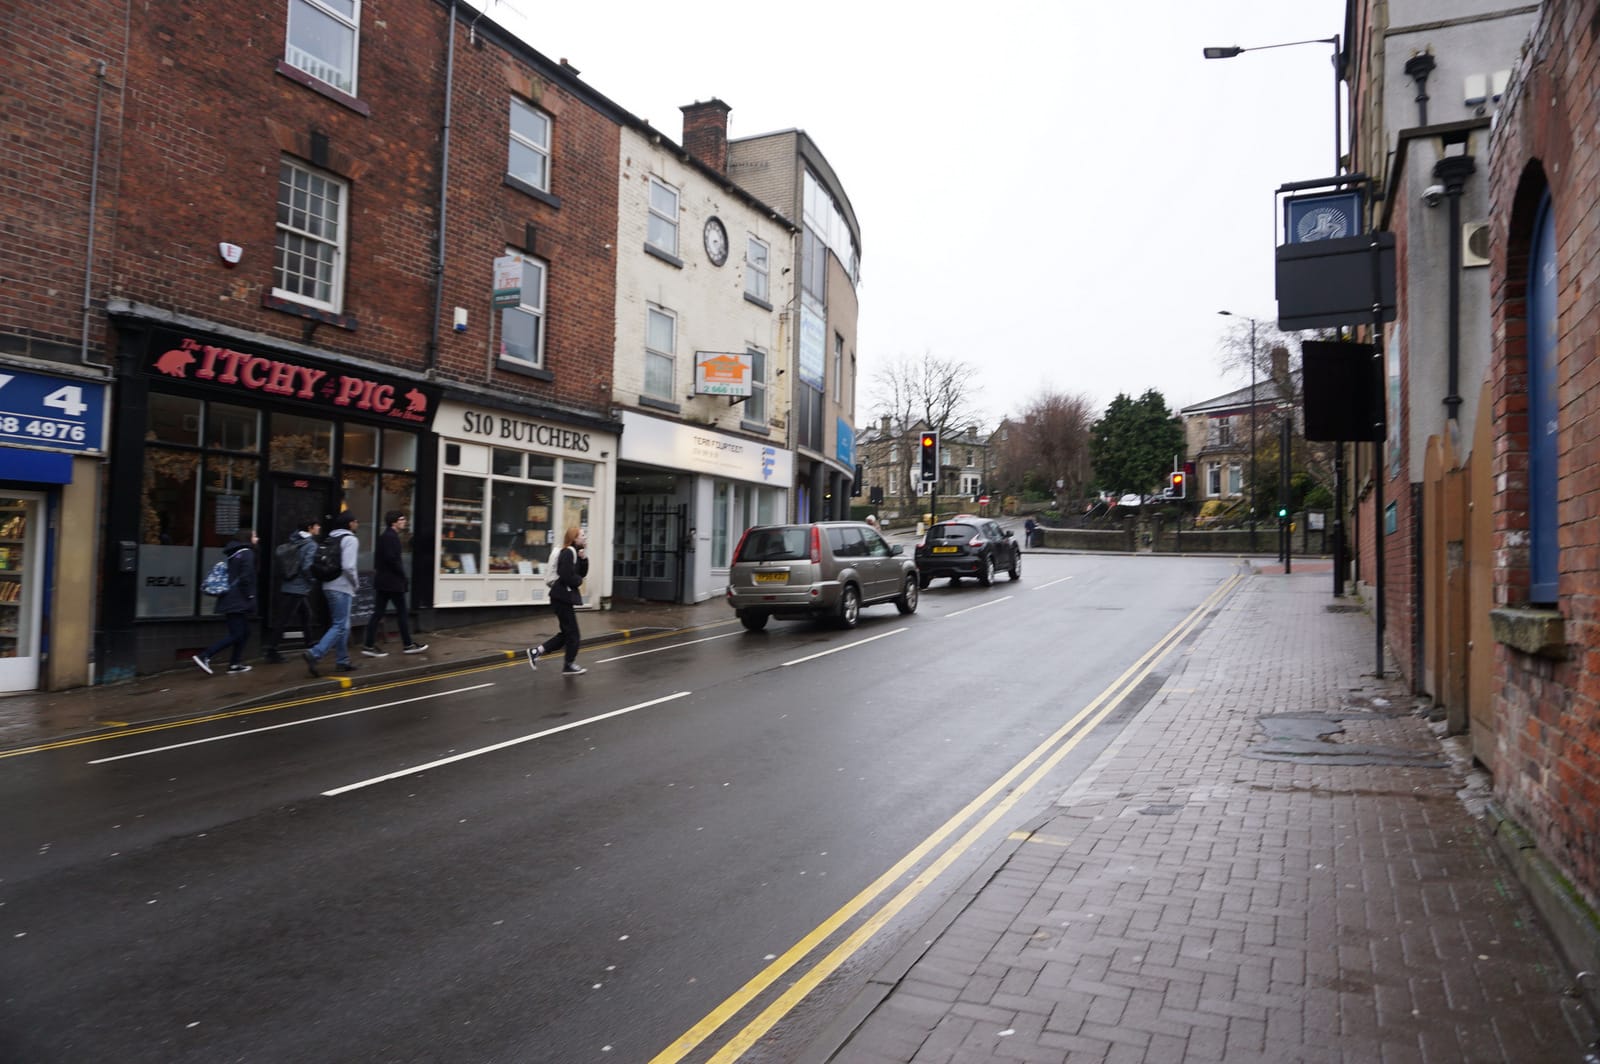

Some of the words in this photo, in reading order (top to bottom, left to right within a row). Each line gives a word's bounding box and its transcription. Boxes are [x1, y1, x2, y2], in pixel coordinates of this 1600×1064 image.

[181, 338, 201, 351] The
[195, 345, 328, 399] ITCHY
[334, 376, 395, 412] PIG
[43, 385, 88, 416] 4
[0, 416, 20, 433] 8
[25, 420, 86, 441] 4976
[463, 411, 494, 436] S10
[500, 417, 590, 452] BUTCHERS
[145, 576, 187, 588] REAL
